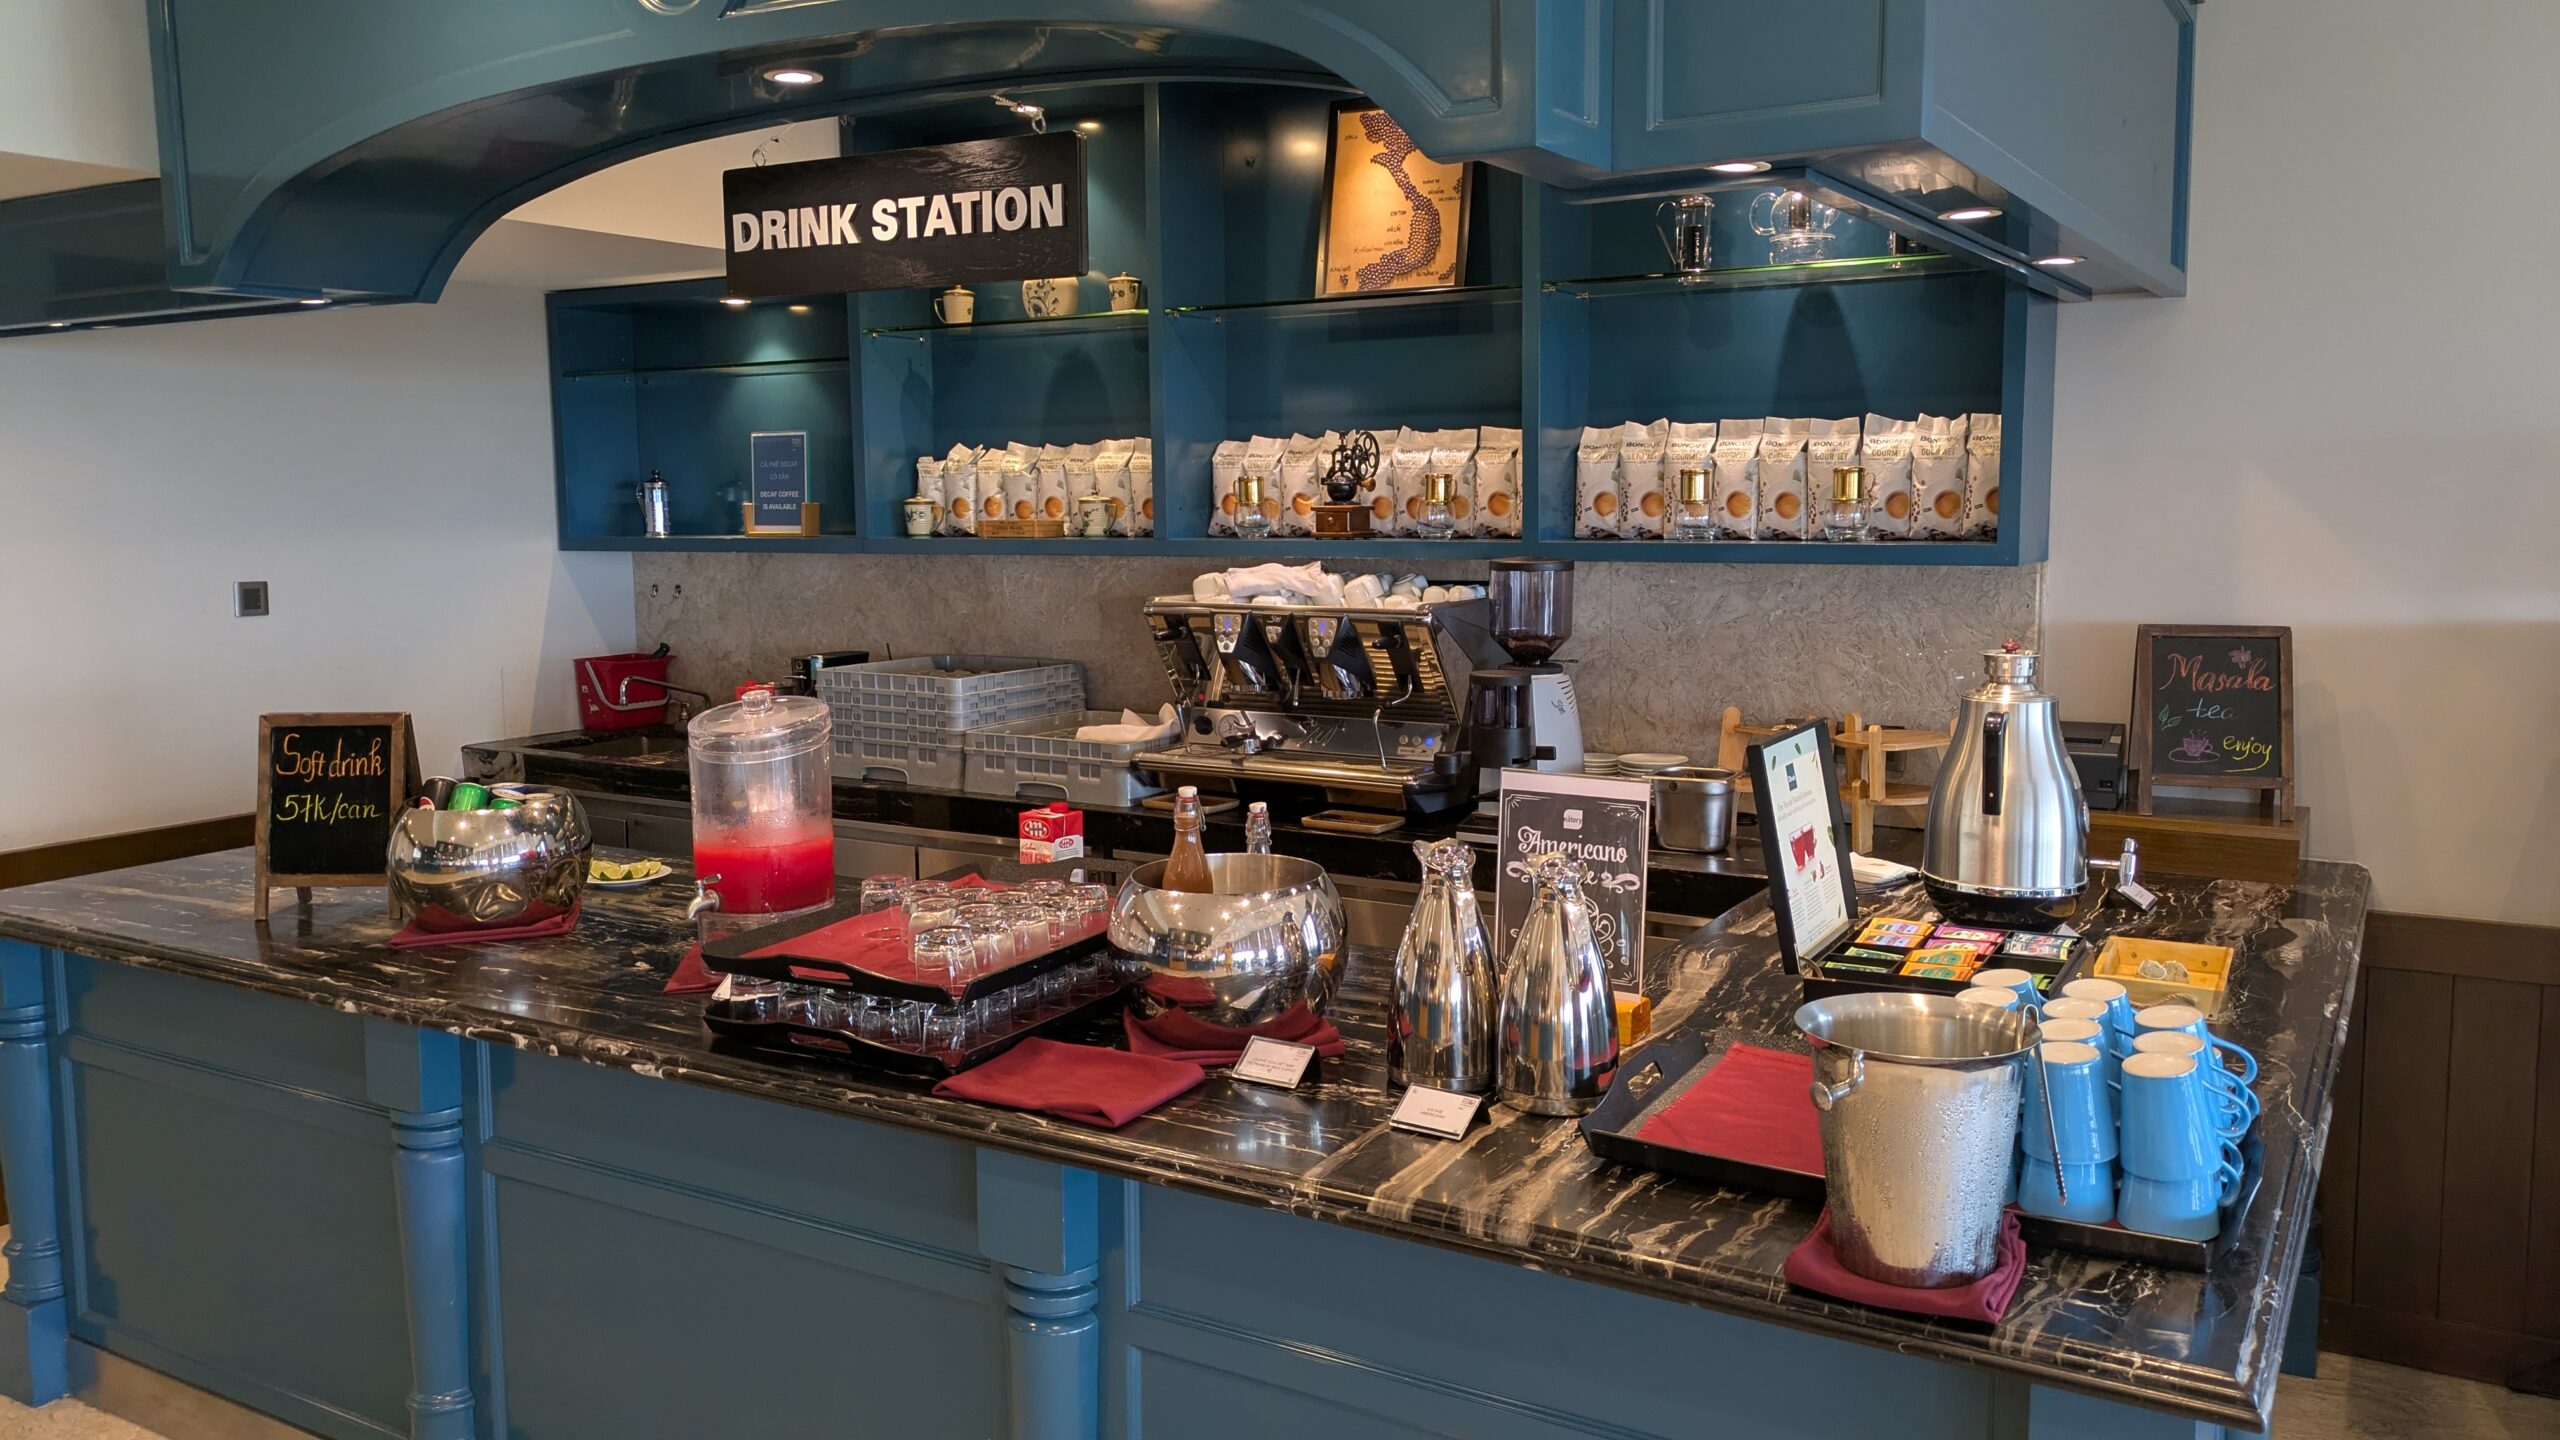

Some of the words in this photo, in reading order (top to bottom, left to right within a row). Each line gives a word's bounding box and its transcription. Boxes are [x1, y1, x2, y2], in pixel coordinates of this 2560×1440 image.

[732, 203, 856, 253] DRINK
[871, 183, 1064, 241] STATION
[2159, 653, 2276, 693] Masala
[2186, 698, 2239, 720] tea
[276, 733, 326, 783] Soft
[328, 737, 386, 778] drink
[2222, 735, 2273, 773] enjoy
[1517, 825, 1628, 863] Americano
